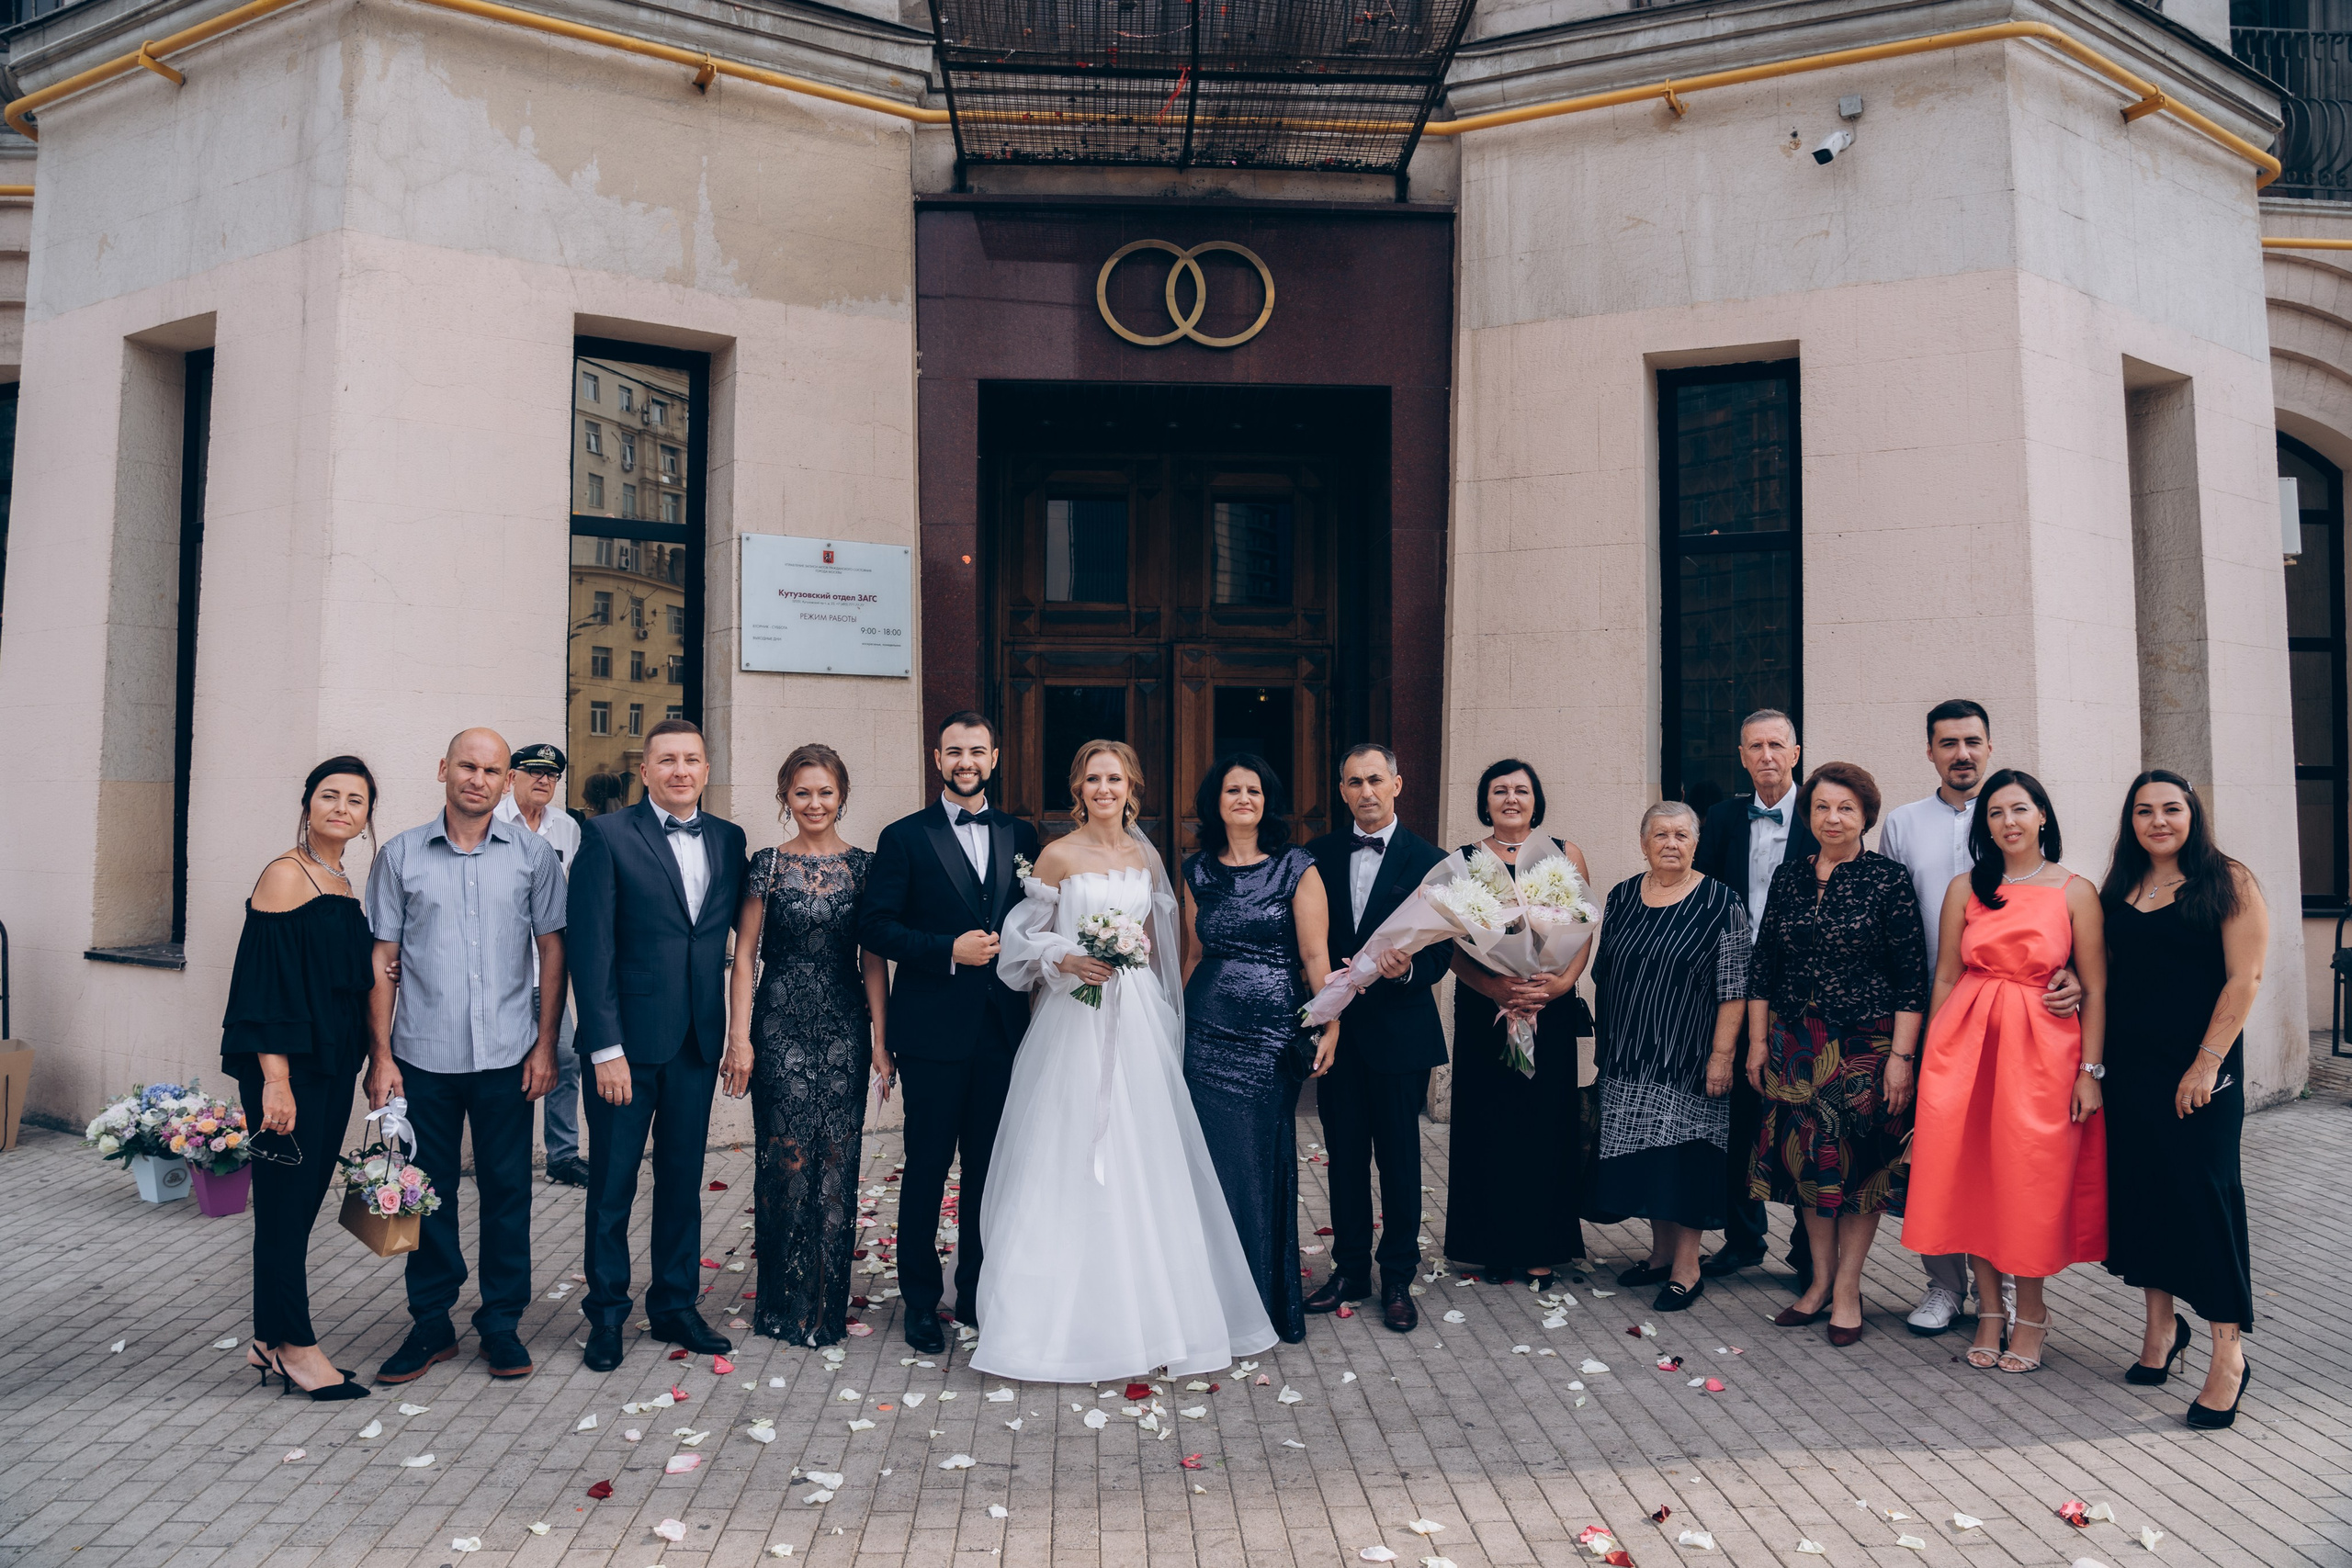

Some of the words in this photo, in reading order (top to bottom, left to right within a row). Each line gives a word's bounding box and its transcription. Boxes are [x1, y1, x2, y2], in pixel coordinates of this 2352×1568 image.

[778, 589, 831, 600] Кутузовский
[857, 593, 877, 603] ЗАГС
[799, 613, 827, 621] РЕЖИМ
[829, 615, 857, 623] РАБОТЫ
[860, 626, 876, 635] 9:00
[883, 627, 901, 636] 18:00
